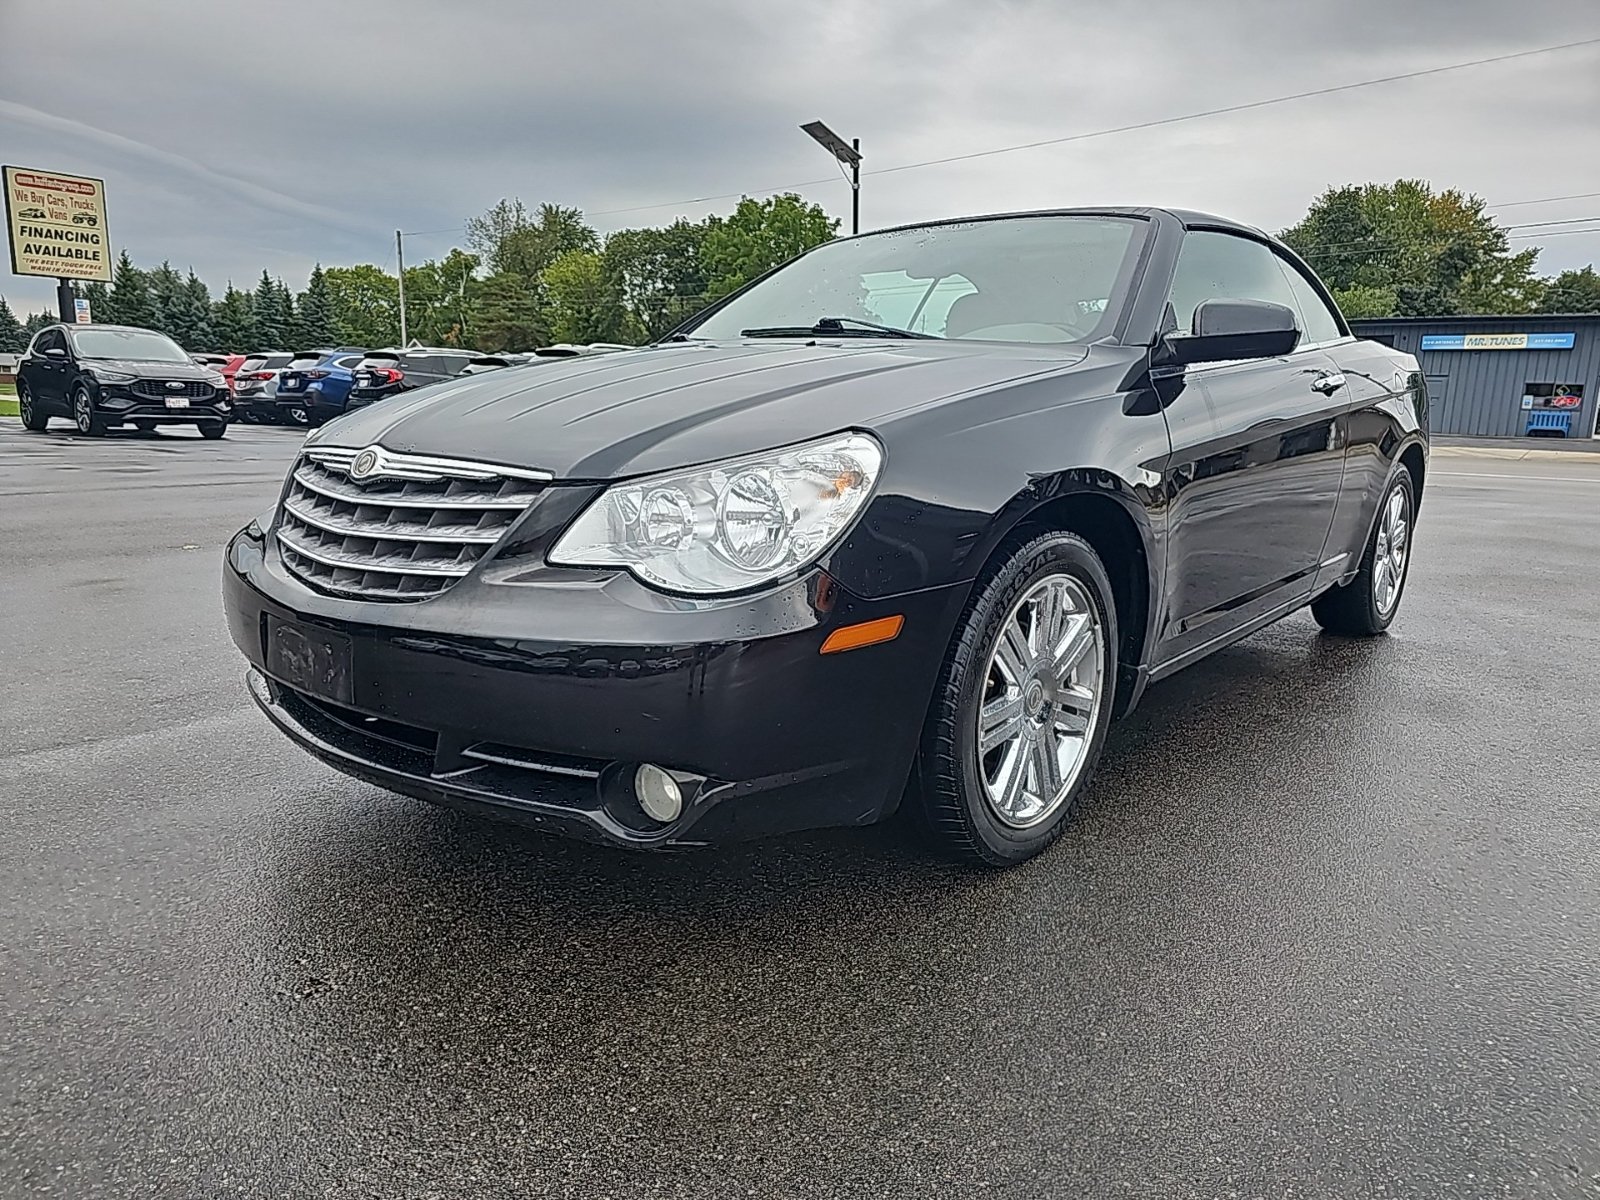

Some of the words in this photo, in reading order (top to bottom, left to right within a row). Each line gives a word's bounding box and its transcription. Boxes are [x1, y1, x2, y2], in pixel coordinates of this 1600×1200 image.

[14, 189, 29, 202] We
[30, 191, 45, 207] Buy
[47, 194, 68, 209] Cars,
[69, 196, 97, 213] Trucks,
[48, 207, 68, 221] Vans
[20, 225, 100, 245] FINANCING
[23, 243, 101, 261] AVAILABLE
[85, 263, 103, 271] FREE
[1466, 337, 1487, 347] MR.
[1488, 336, 1525, 346] TUNES
